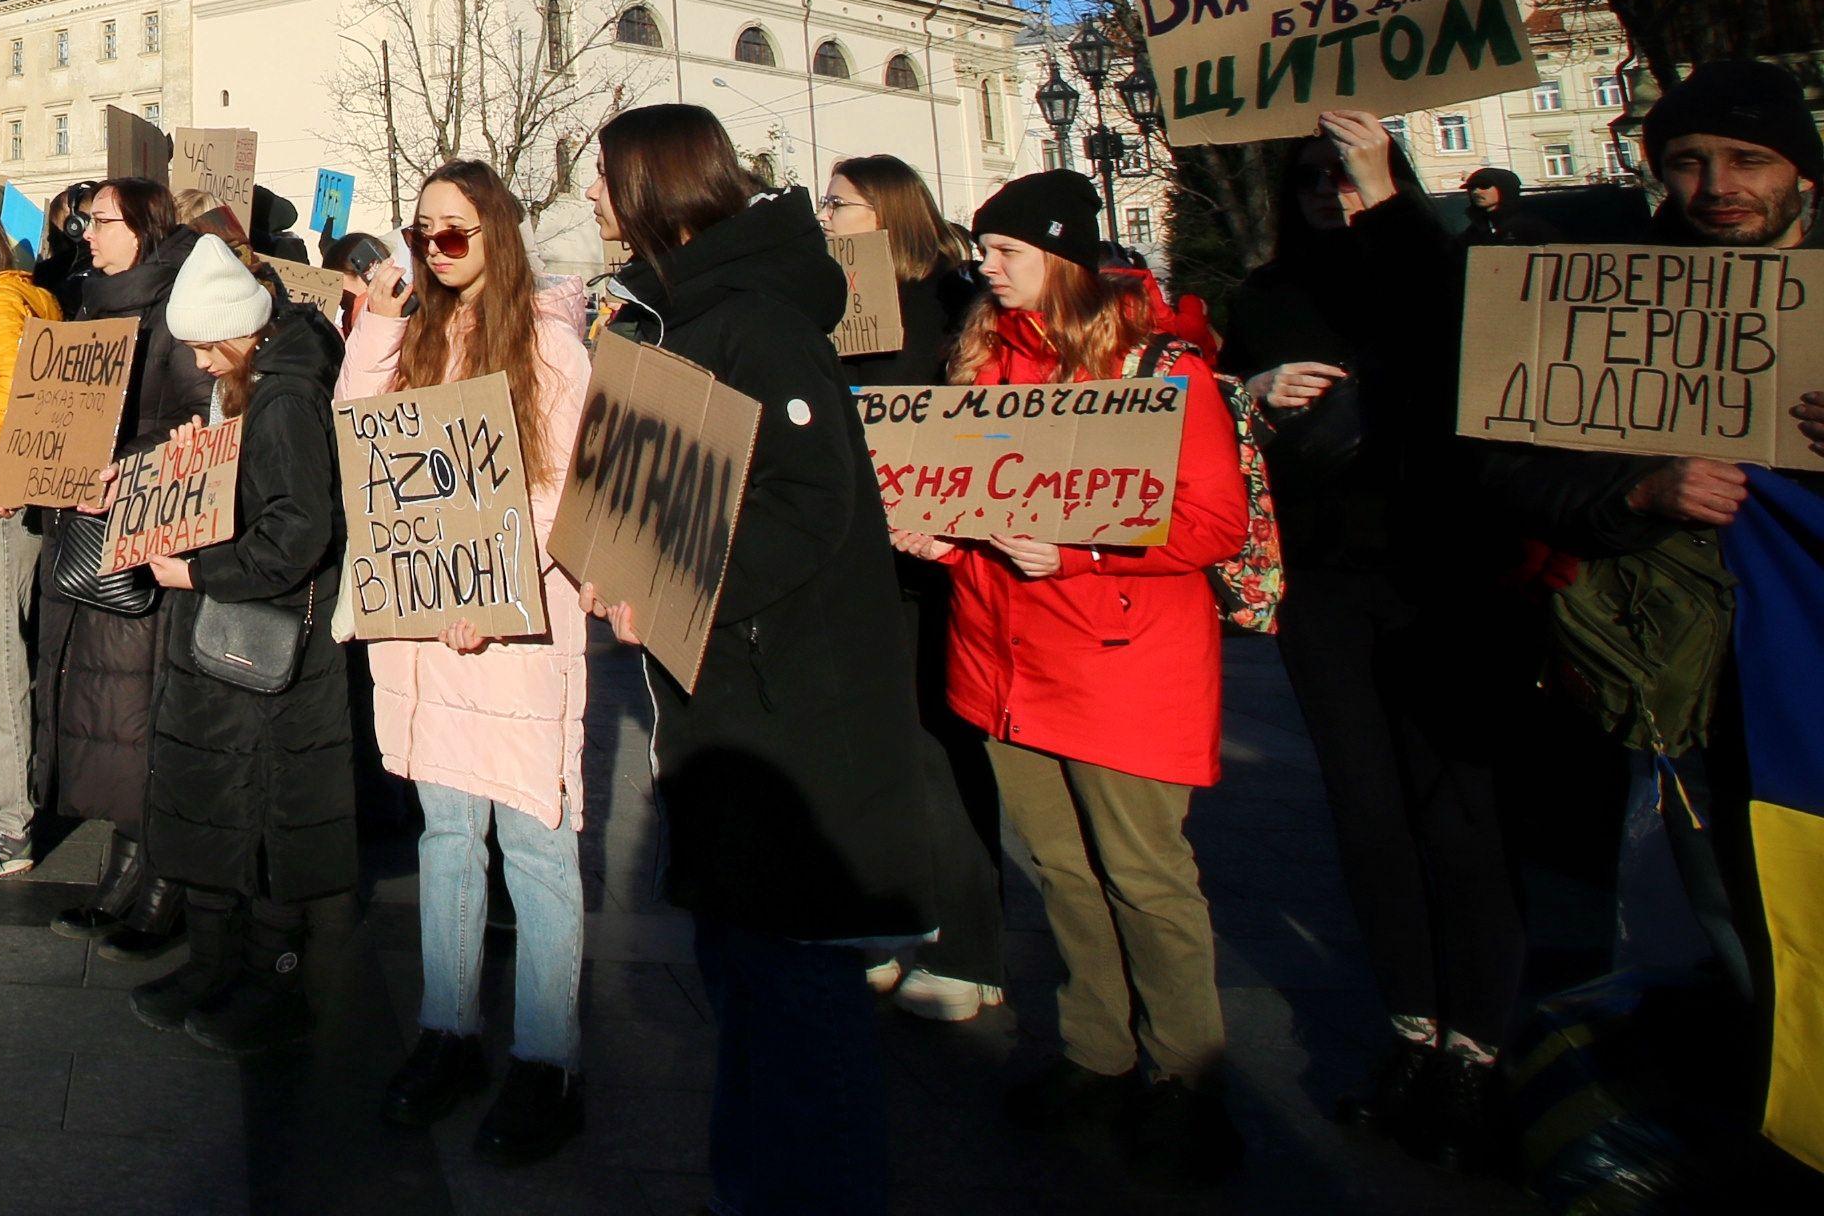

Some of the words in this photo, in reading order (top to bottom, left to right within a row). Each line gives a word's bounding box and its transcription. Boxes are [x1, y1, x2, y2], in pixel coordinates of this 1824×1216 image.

[184, 140, 214, 172] ЧАС
[1520, 251, 1805, 311] ПОВЕРНІТЬ
[1562, 305, 1776, 374] ГЕРОЇВ
[1485, 362, 1753, 439] ДОДОМУ
[7, 429, 67, 463] ПОЛОН
[117, 451, 153, 499] НЕ
[24, 466, 102, 504] ВБИВАЄ
[105, 473, 208, 542] ПОЛОН
[353, 557, 389, 615] В
